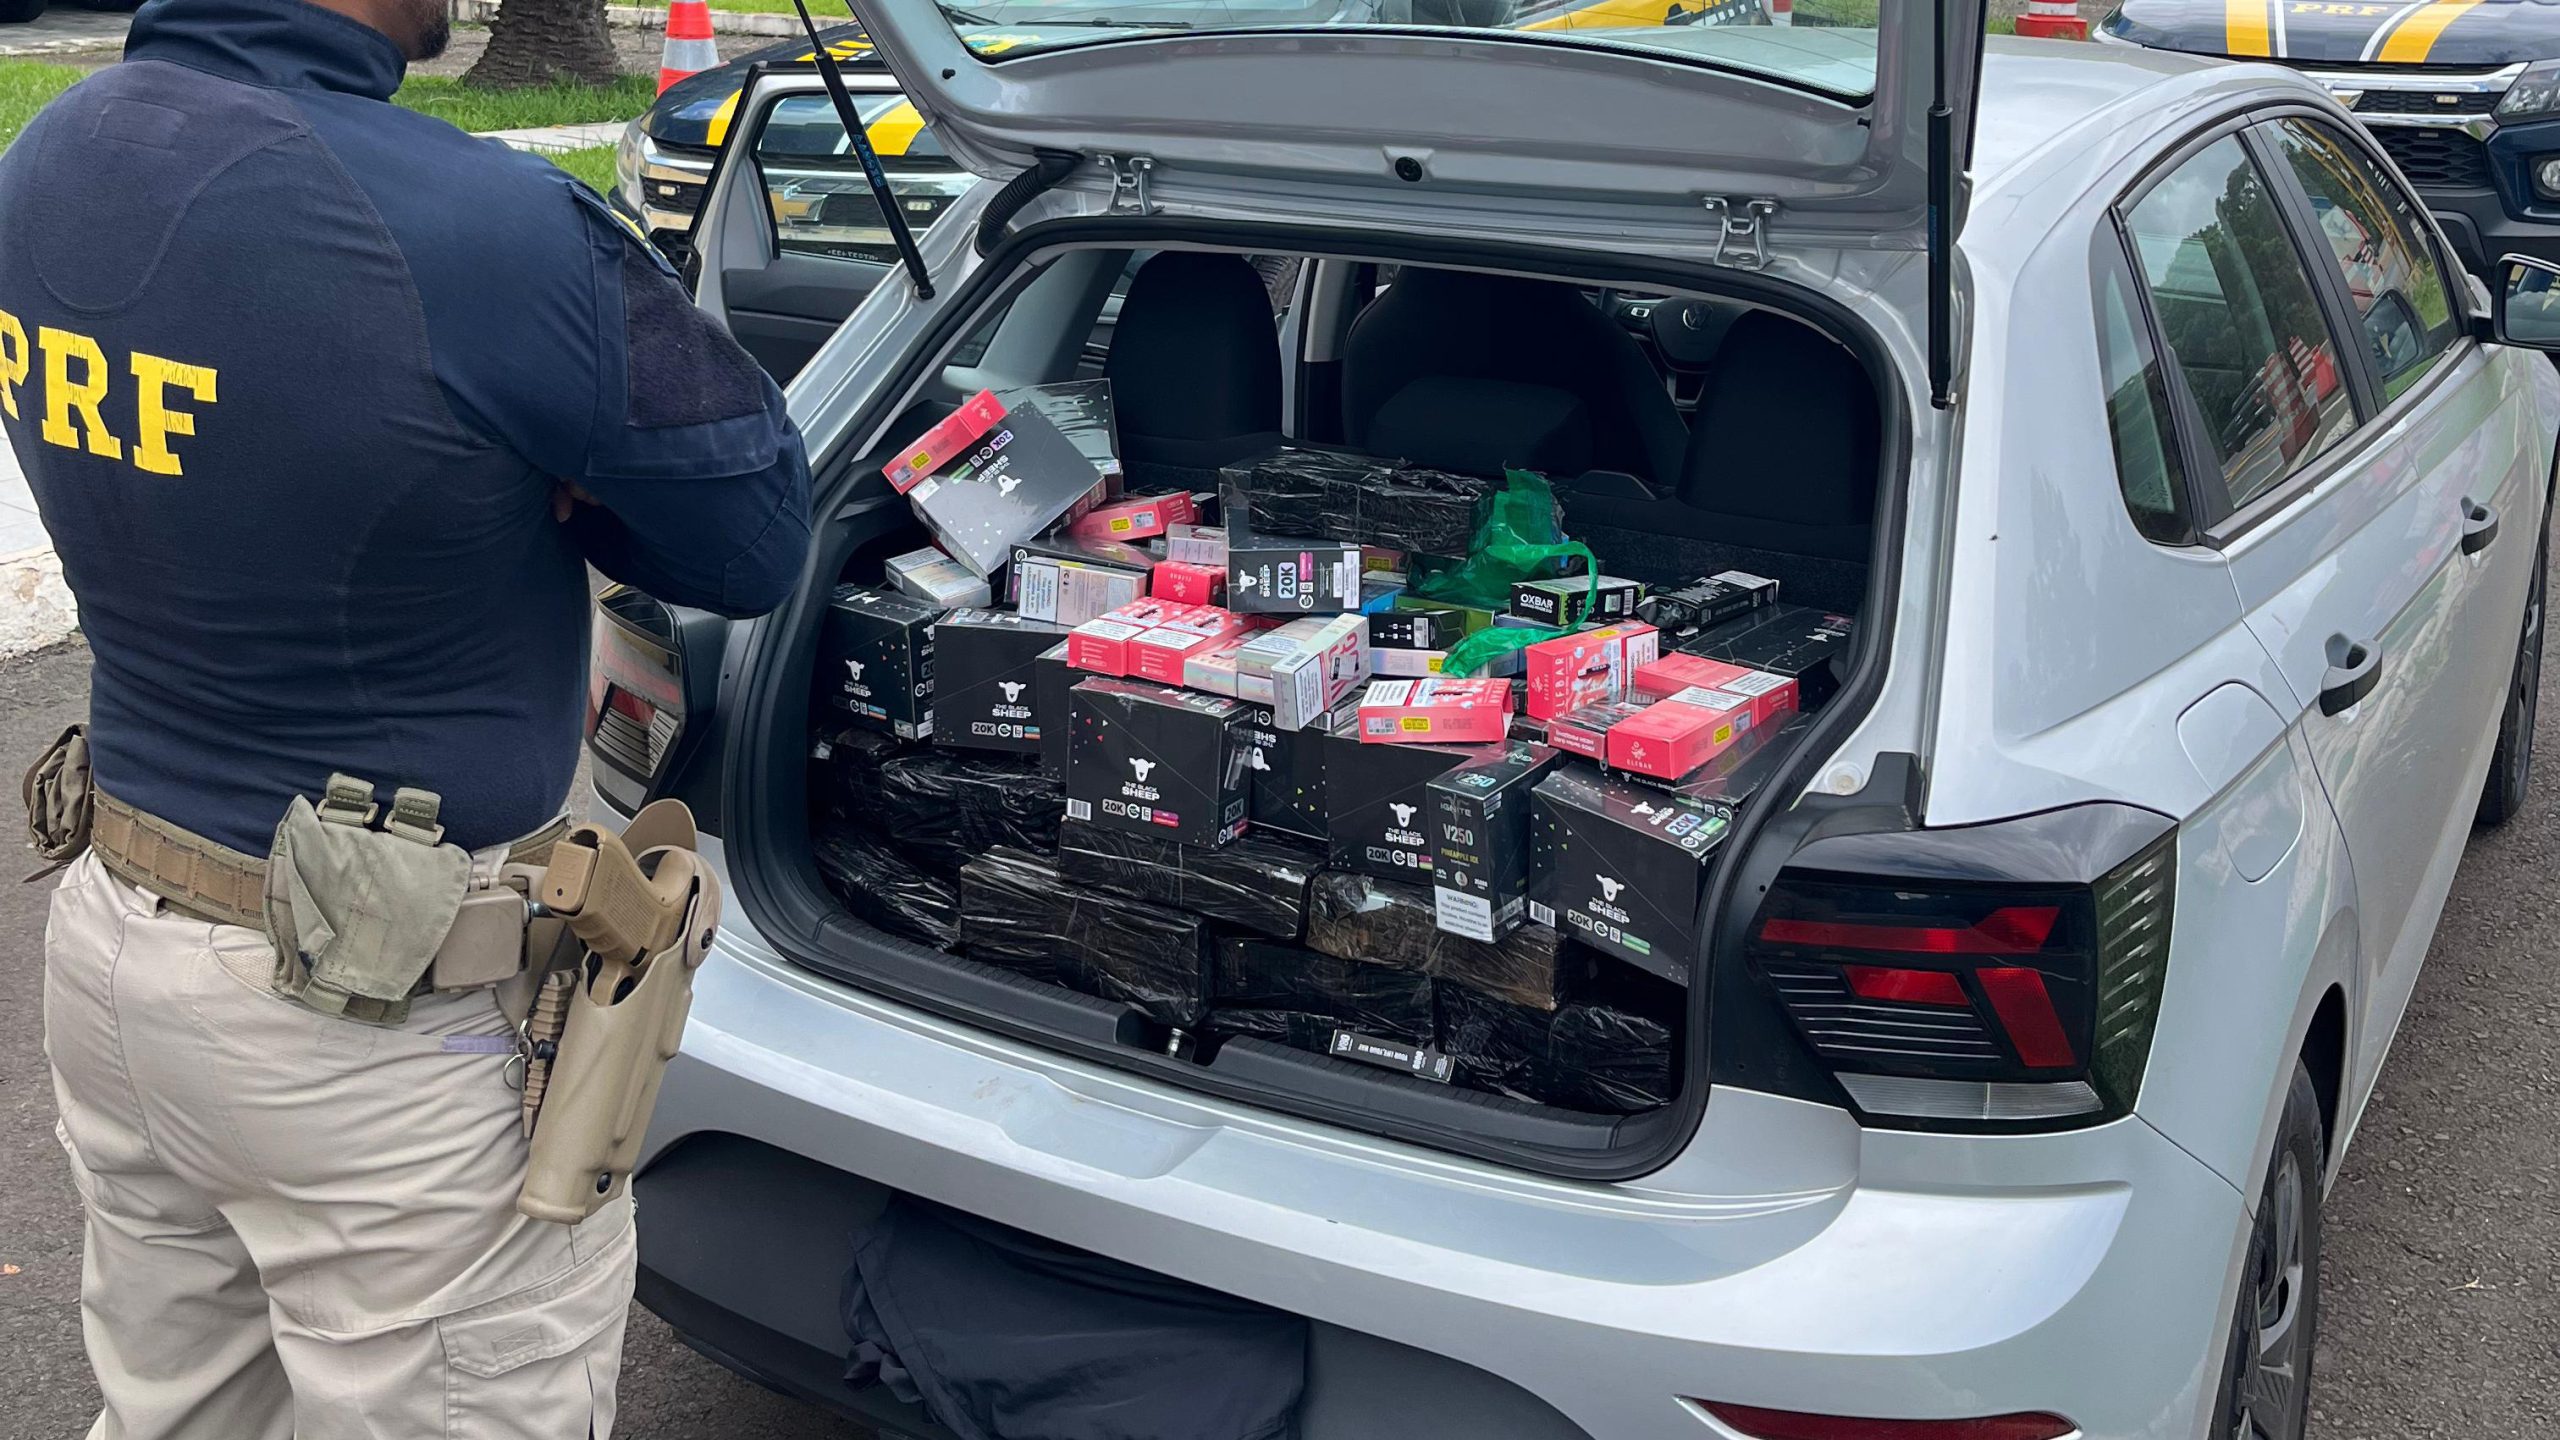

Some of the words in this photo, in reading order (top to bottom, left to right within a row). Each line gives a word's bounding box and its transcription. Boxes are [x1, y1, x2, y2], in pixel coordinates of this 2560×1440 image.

[2290, 3, 2388, 16] PRF
[0, 309, 217, 475] PRF
[992, 431, 1012, 449] 20K
[977, 455, 1009, 482] SHEEP
[1263, 564, 1271, 597] SHEEP
[1281, 566, 1294, 595] 20K
[1520, 593, 1554, 609] OXBAR
[844, 684, 872, 698] SHEEP
[1555, 658, 1565, 718] ELFBAR
[992, 708, 1031, 718] SHEEP
[974, 724, 994, 734] 20K
[1254, 731, 1276, 743] SHE
[1626, 758, 1652, 770] ELFBAR
[1124, 781, 1137, 789] THE
[1137, 784, 1157, 793] BLACK
[1454, 771, 1496, 788] V250
[1121, 786, 1160, 801] SHEEP
[1104, 801, 1124, 814] 20K
[1226, 802, 1242, 820] 20K
[1440, 802, 1472, 817] IGNITE
[1669, 815, 1695, 834] 20K
[1385, 832, 1424, 846] SHEEP
[1401, 829, 1421, 837] BLACK
[1442, 823, 1474, 846] V250
[1368, 849, 1389, 860] 20K
[1588, 901, 1630, 924] SHEEP
[1591, 896, 1604, 906] THE
[1605, 902, 1627, 916] BLACK
[1569, 911, 1591, 928] 20K
